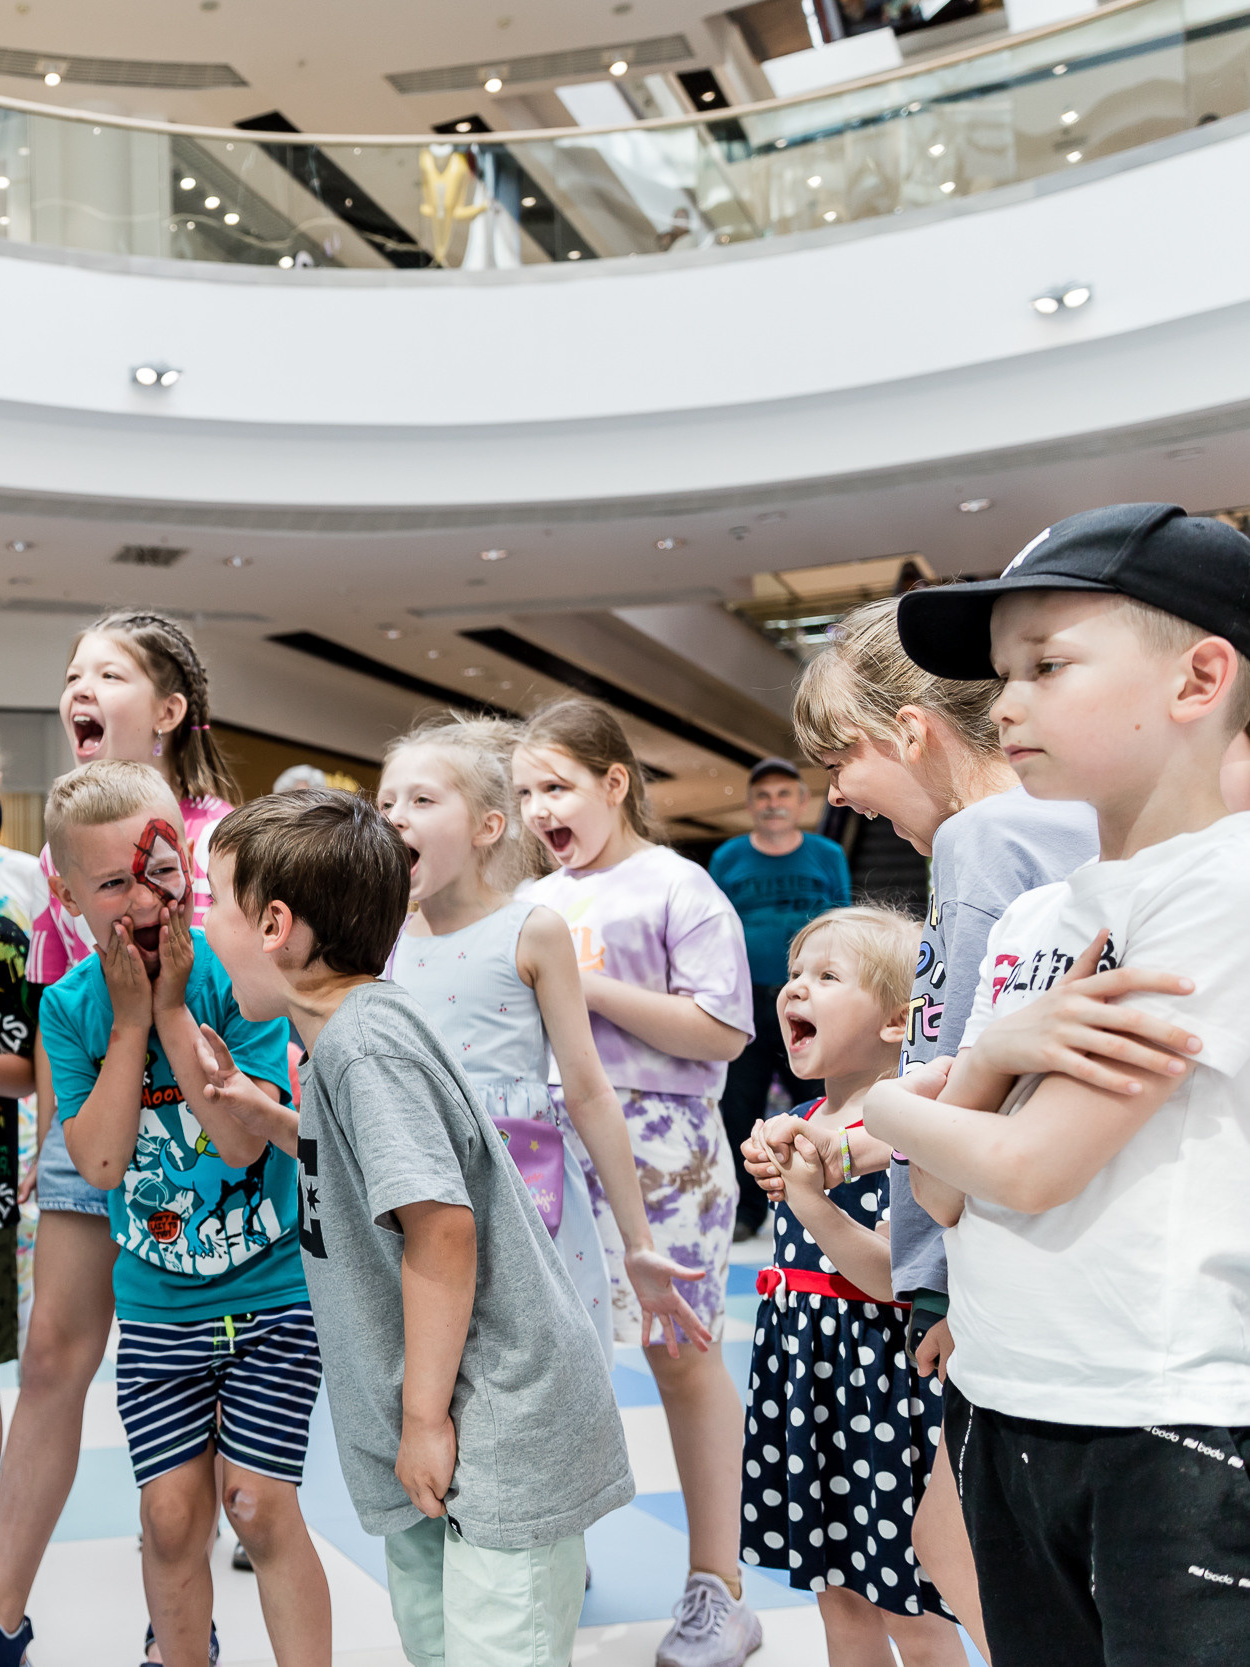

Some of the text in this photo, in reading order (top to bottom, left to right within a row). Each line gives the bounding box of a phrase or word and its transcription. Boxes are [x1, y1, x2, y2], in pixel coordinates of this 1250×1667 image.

[141, 1087, 184, 1106] HOOL
[1197, 1441, 1225, 1461] bodo
[1203, 1568, 1234, 1585] bodo
